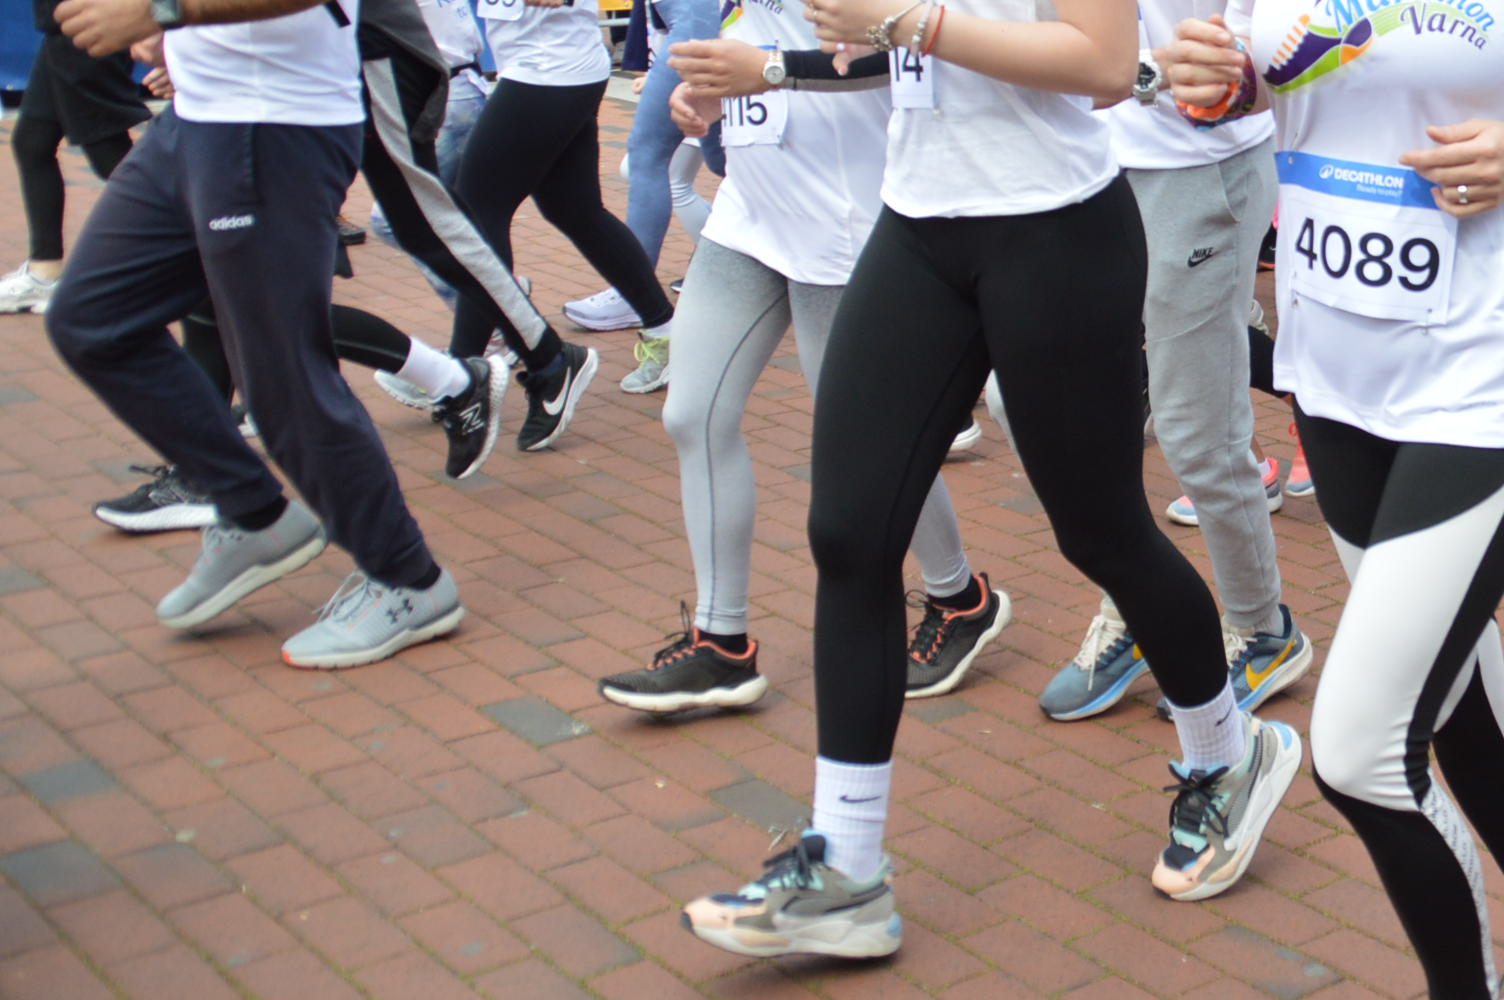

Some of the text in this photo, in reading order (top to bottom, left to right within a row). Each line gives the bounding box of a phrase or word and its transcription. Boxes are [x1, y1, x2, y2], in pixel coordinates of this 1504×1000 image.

[1400, 2, 1487, 50] Varna
[1334, 168, 1404, 188] DECATHLON
[209, 214, 255, 231] adidas
[1296, 217, 1440, 292] 4089
